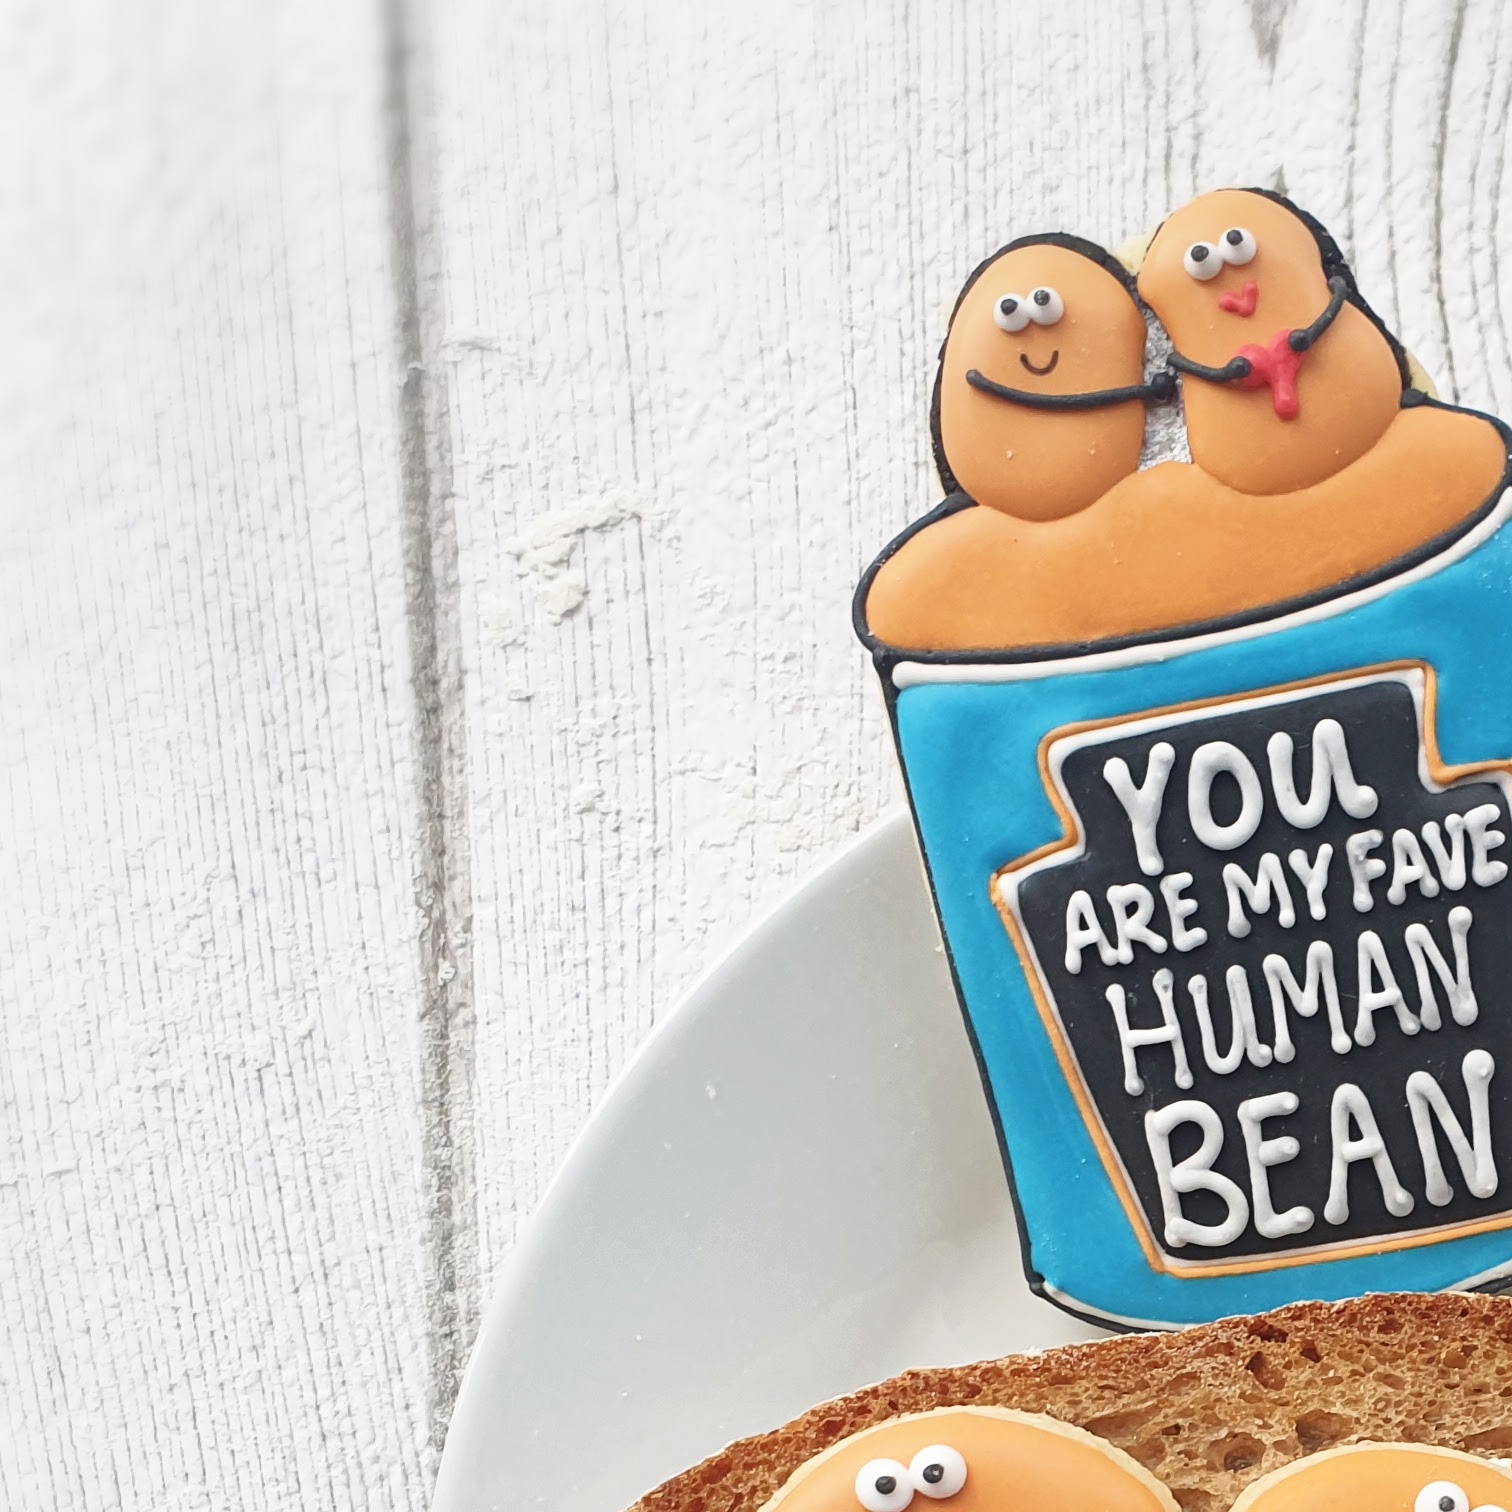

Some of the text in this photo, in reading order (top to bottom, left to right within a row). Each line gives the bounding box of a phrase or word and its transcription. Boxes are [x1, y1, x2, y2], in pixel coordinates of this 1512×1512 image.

[1103, 719, 1378, 876] YOU
[1064, 803, 1508, 974] ARE MY FAVE
[1105, 906, 1478, 1096] HUMAN
[1144, 1049, 1499, 1247] BEAN
